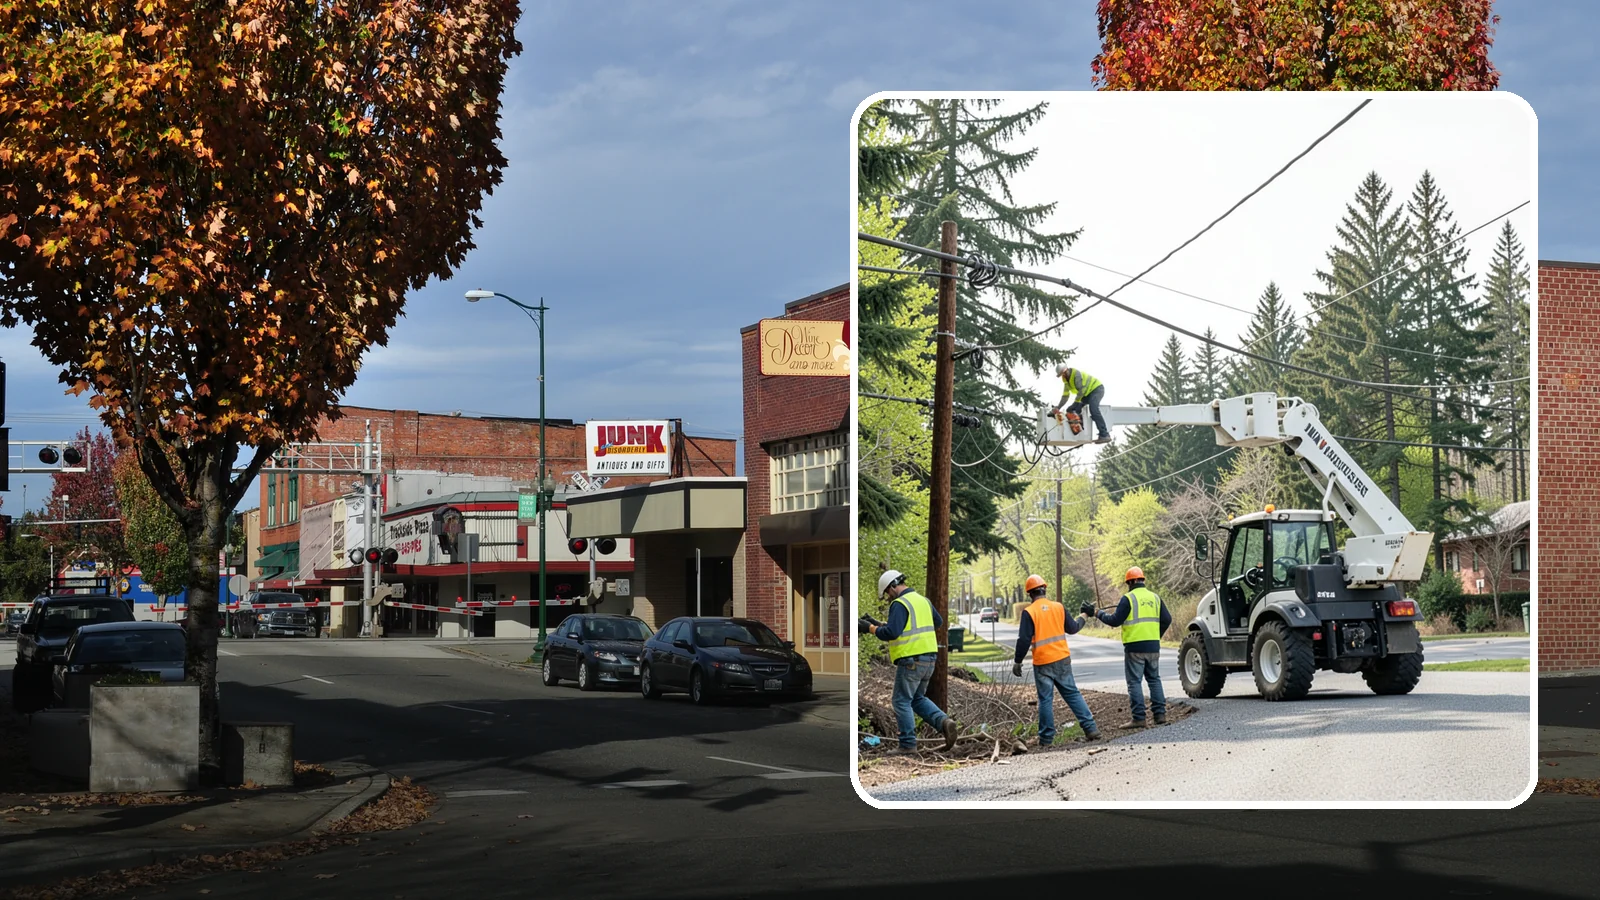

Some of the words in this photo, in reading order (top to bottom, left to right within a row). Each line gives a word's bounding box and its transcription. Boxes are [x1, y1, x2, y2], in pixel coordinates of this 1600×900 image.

[595, 425, 666, 457] JUNK
[607, 446, 646, 454] DISORDERLY
[596, 461, 628, 470] ANTIQUES
[631, 461, 644, 470] AND
[646, 460, 665, 470] GIFTS
[390, 522, 413, 540] Trackside
[414, 519, 429, 535] Pizza
